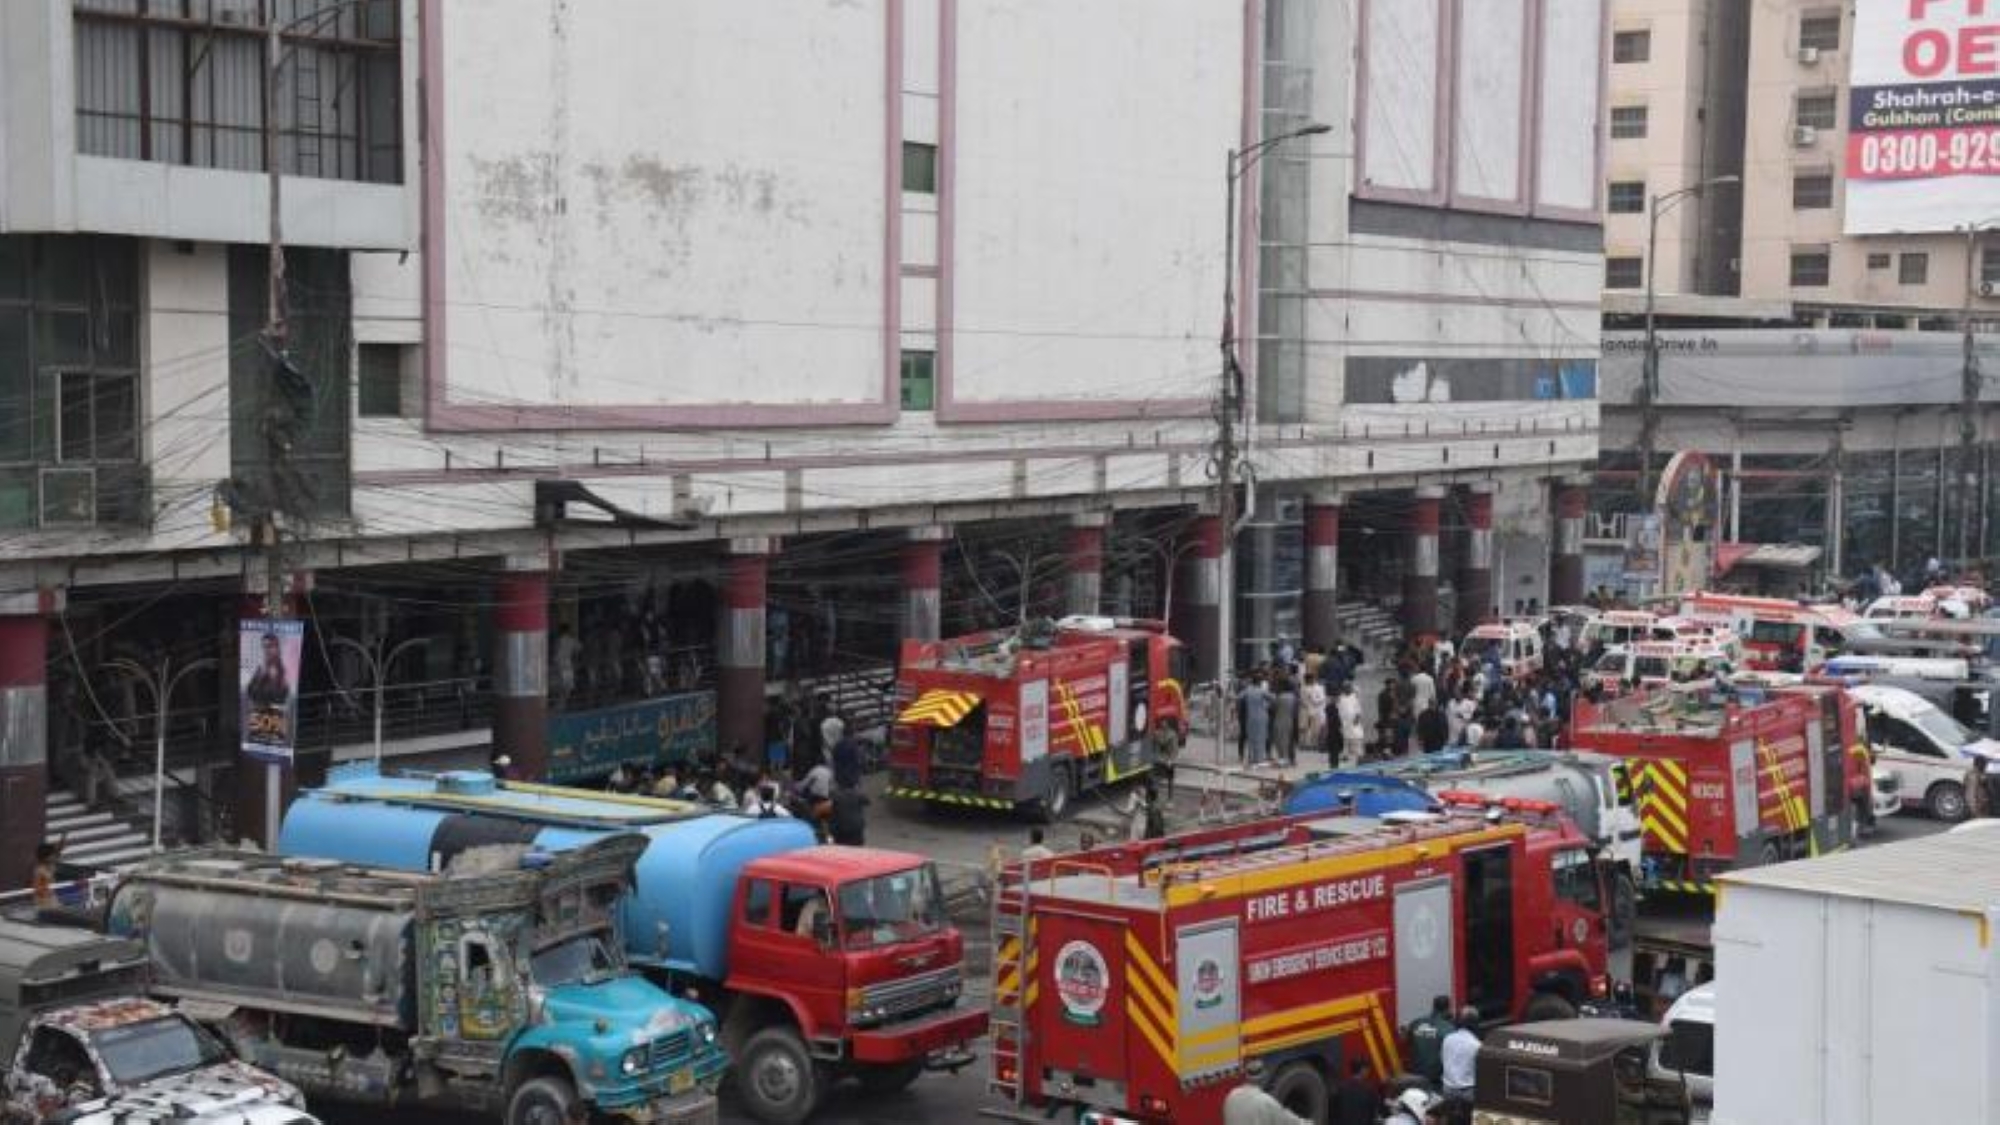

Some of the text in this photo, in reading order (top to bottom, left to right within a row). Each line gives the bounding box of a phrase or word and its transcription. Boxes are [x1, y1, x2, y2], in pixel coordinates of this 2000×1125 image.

[1863, 110, 1940, 127] Gulshan
[1600, 339, 1646, 352] onda
[1247, 875, 1385, 922] FIRE & RESCUE
